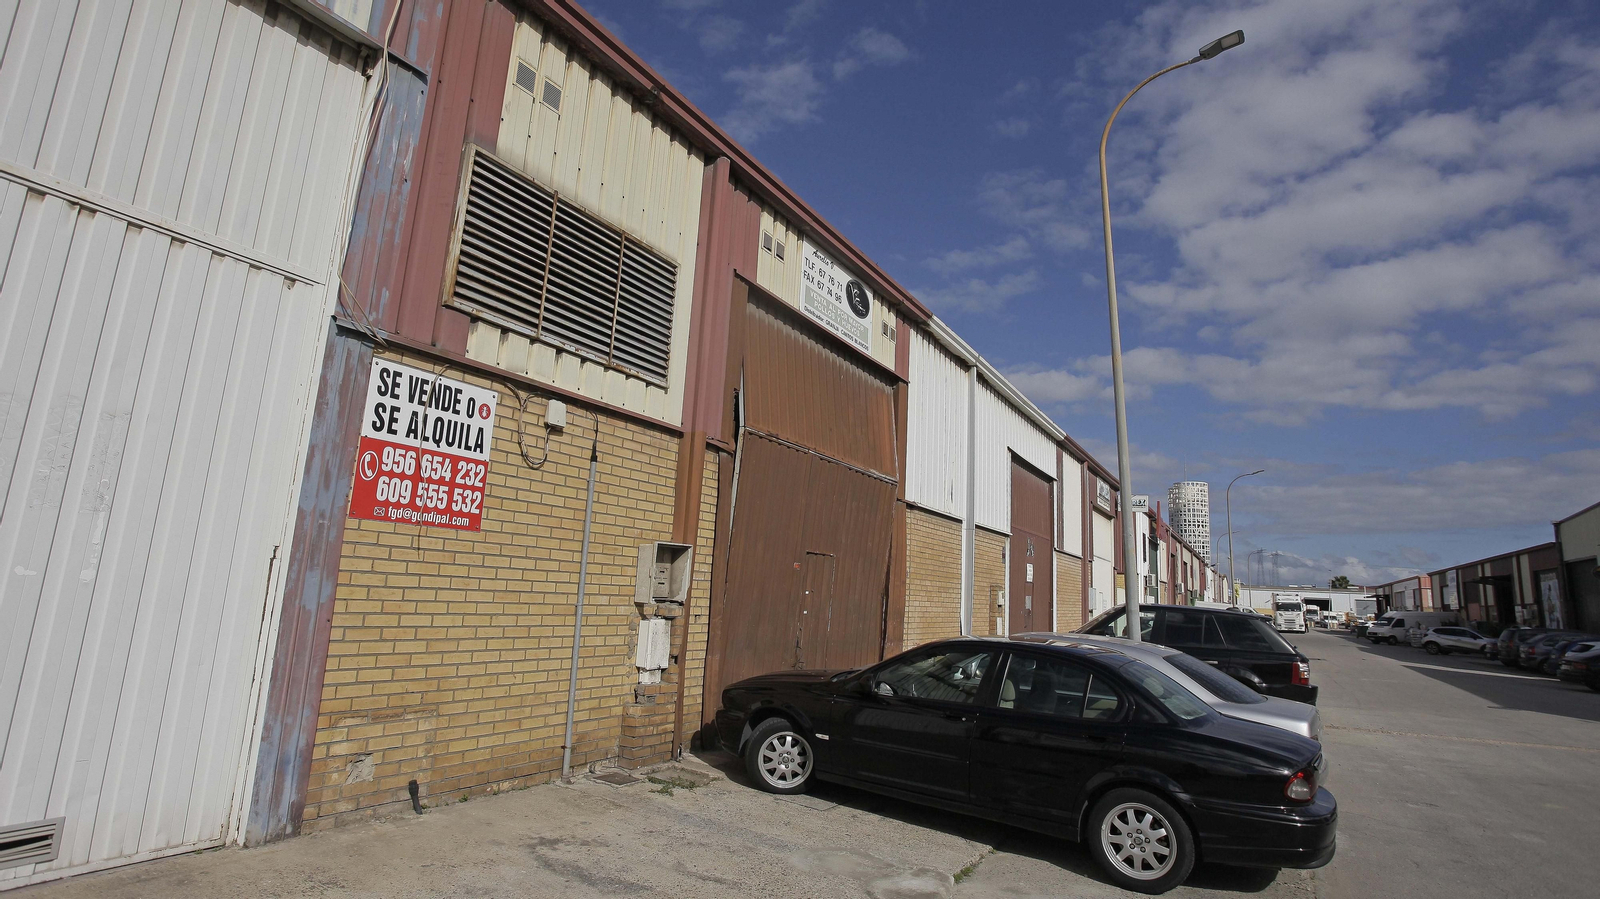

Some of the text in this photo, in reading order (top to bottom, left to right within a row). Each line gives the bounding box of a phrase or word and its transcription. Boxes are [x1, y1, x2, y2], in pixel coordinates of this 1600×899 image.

[803, 269, 815, 286] FAX
[816, 279, 825, 292] 67
[826, 285, 833, 298] 74
[818, 267, 826, 280] 67
[828, 274, 835, 287] 76
[836, 280, 843, 293] 71
[809, 289, 827, 307] VENTA
[828, 303, 836, 313] AL
[837, 308, 848, 322] POR
[814, 300, 835, 320] POLLOS
[377, 367, 476, 419] SE VENDE O
[371, 402, 484, 454] SE ALQUILA
[381, 446, 485, 487] 956 654 232
[376, 476, 482, 514] 609 555 532
[388, 506, 469, 527] fgd@gondipal.com
